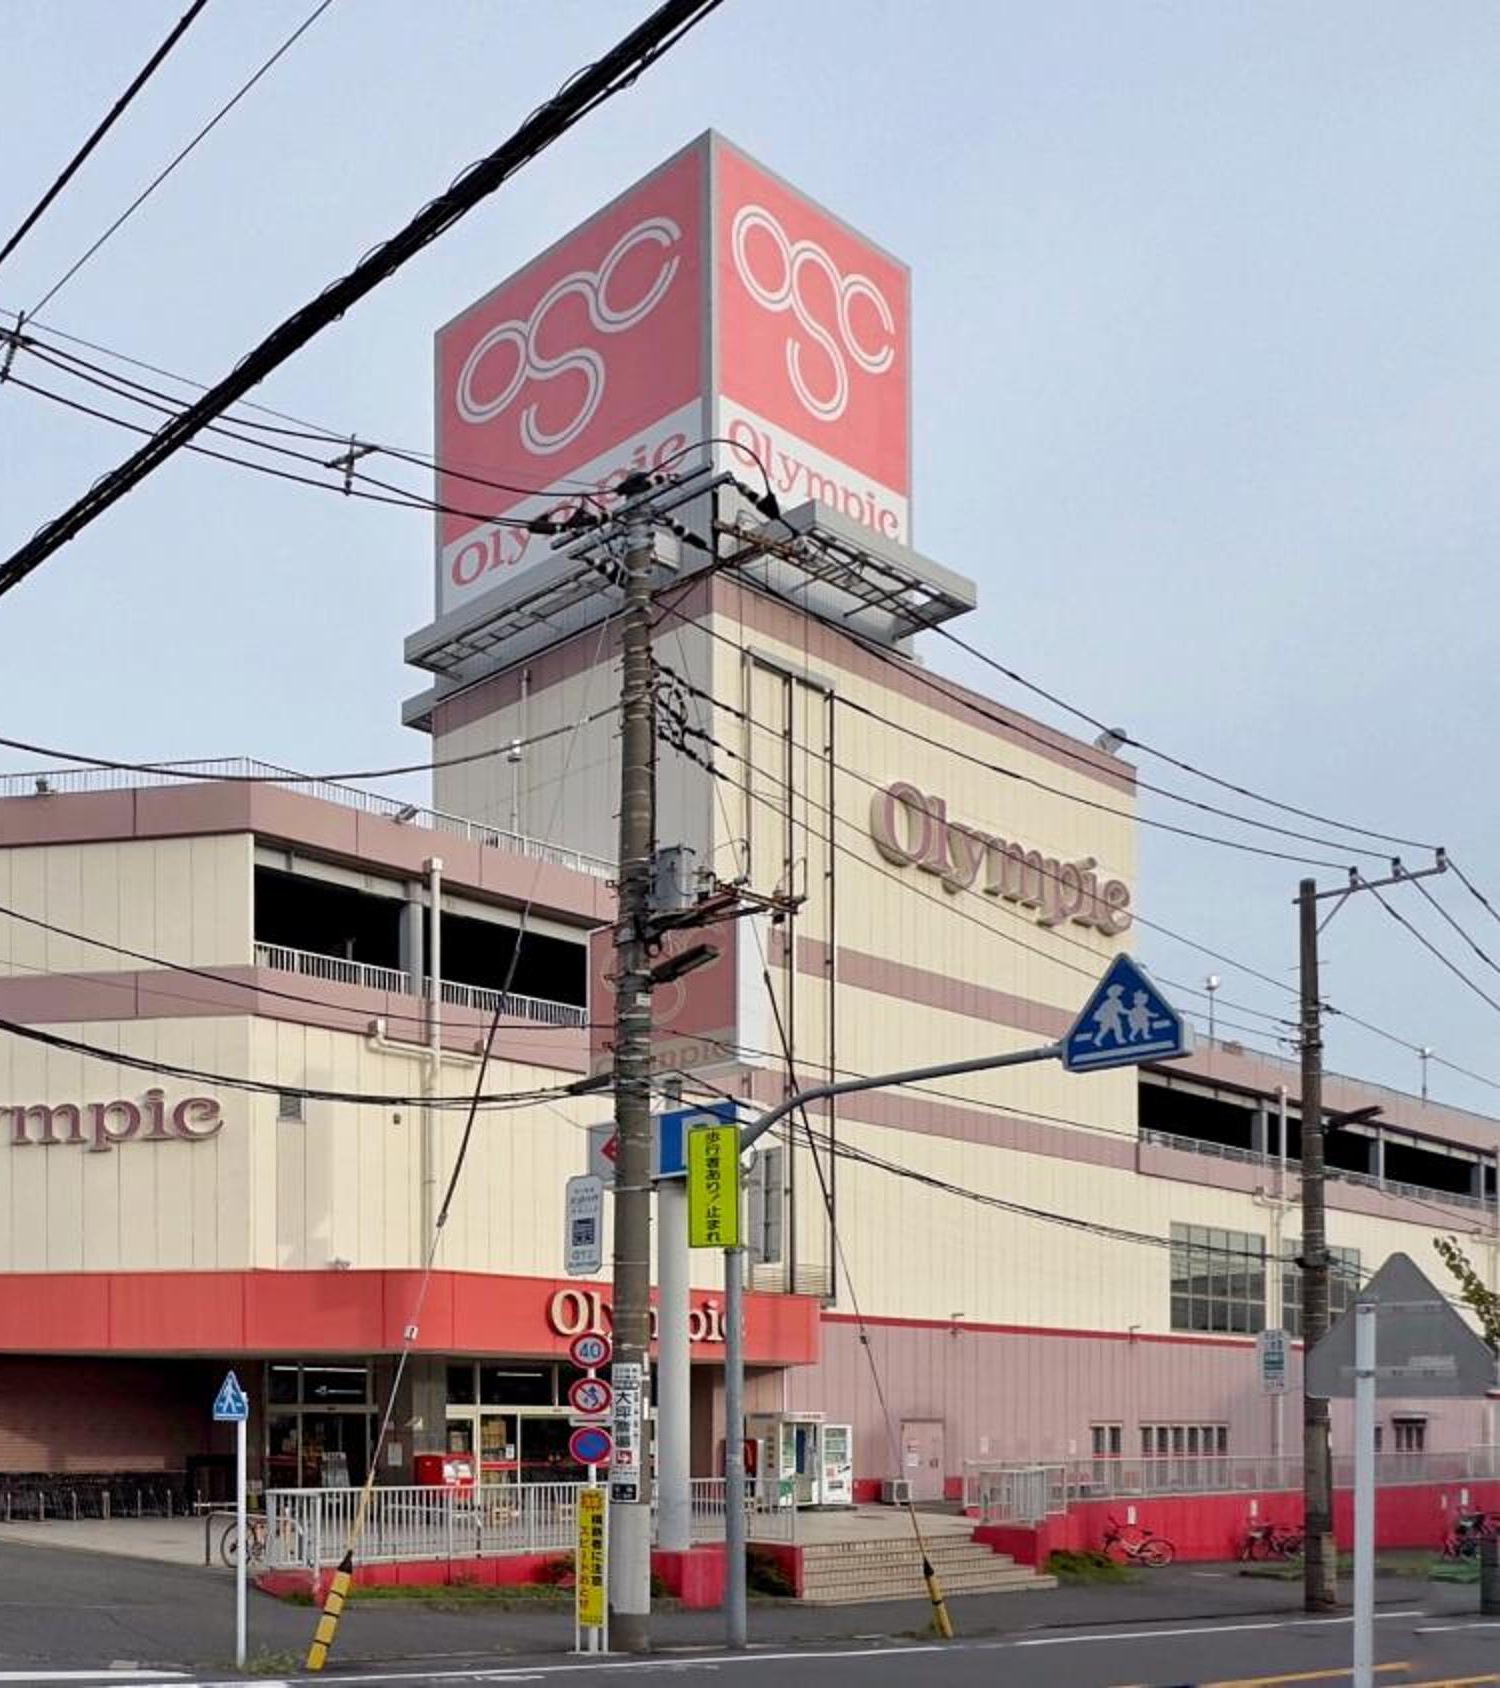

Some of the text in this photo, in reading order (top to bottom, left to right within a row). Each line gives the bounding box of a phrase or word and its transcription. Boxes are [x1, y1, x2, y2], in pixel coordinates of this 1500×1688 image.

[729, 419, 899, 539] Olympic
[870, 781, 1132, 936] Olympic
[579, 1342, 601, 1359] 40
